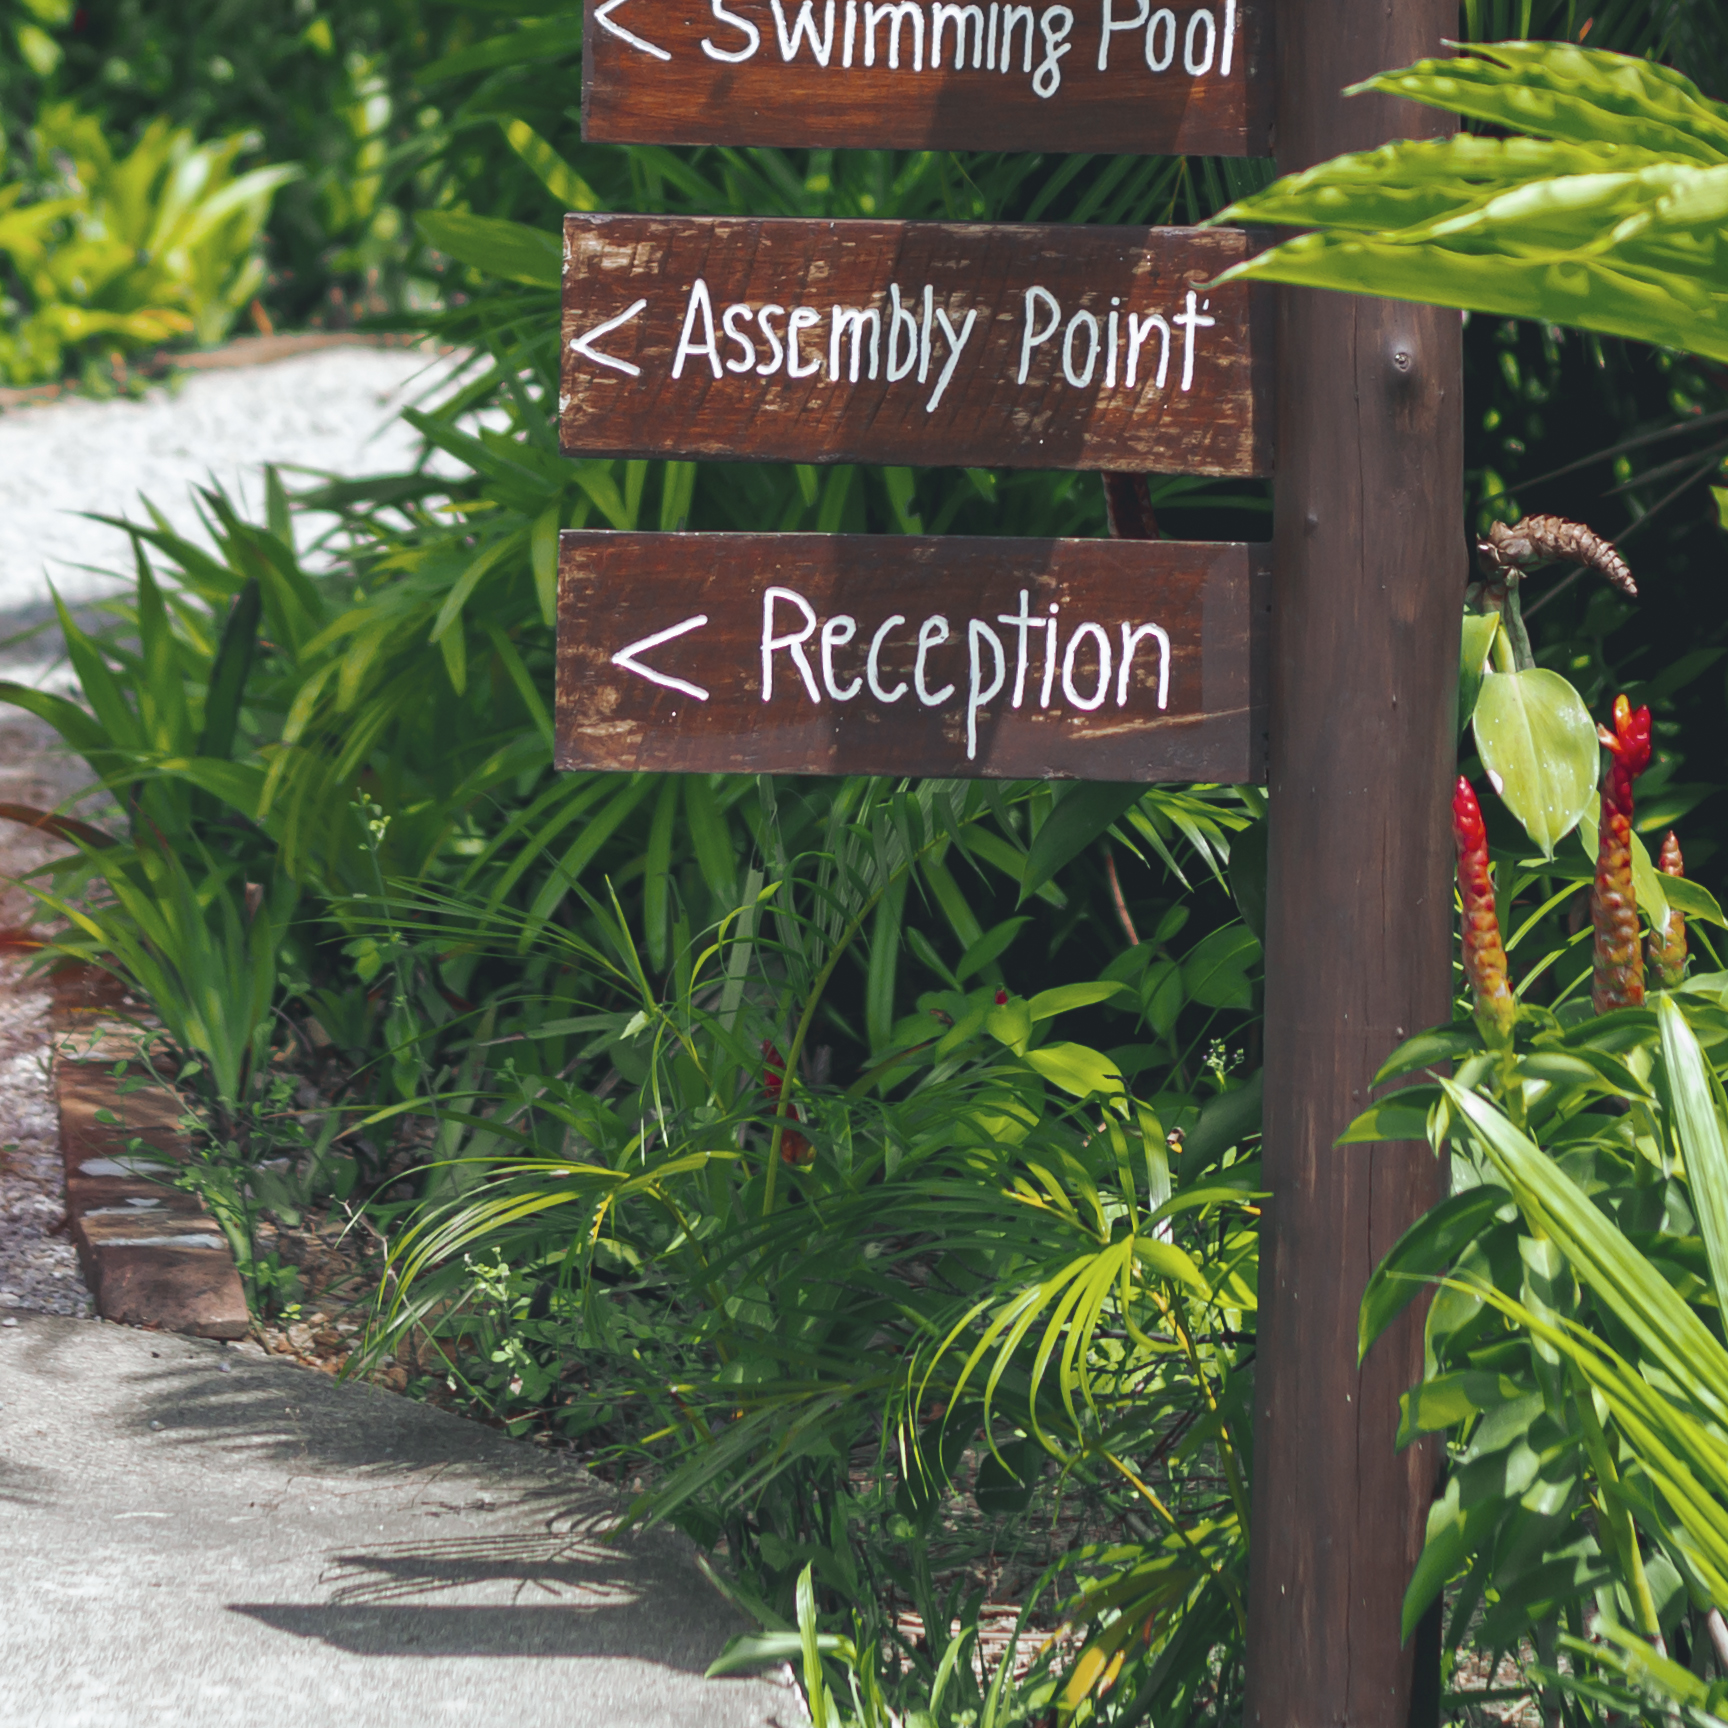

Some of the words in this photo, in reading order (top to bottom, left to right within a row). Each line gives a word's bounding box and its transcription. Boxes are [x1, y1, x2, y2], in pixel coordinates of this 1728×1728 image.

[670, 277, 977, 412] Assembly
[1016, 284, 1215, 392] Point
[760, 585, 1171, 760] Reception
